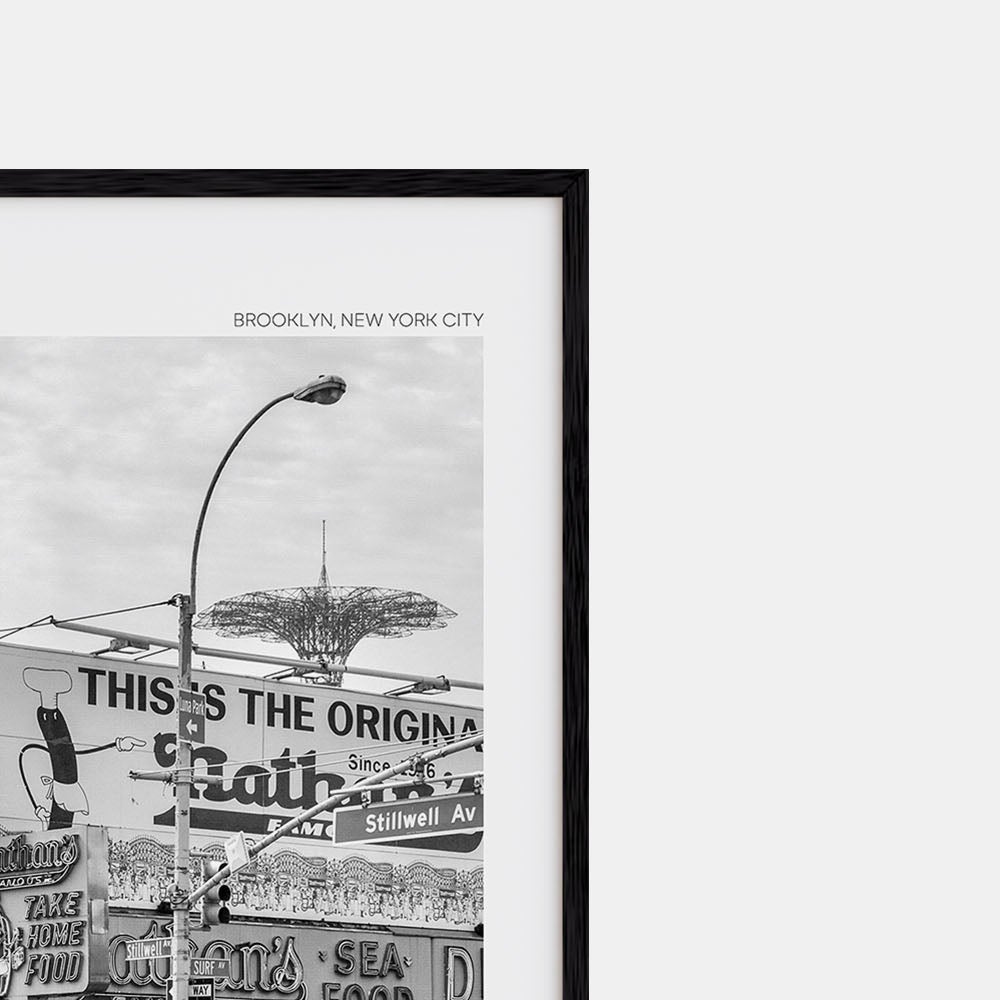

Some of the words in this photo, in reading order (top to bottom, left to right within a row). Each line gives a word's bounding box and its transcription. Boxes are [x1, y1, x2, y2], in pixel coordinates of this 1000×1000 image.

[233, 312, 337, 330] BROOKLYN,
[340, 312, 384, 328] NEW
[387, 312, 438, 328] YORK
[441, 312, 485, 328] CITY
[78, 666, 175, 716] THIS
[189, 682, 226, 722] S
[237, 687, 317, 733] THE
[348, 753, 391, 774] Since
[365, 806, 440, 834] Stillwell
[451, 803, 477, 824] Av
[23, 891, 83, 920] TAKE
[25, 920, 87, 949] HOME
[126, 939, 163, 959] Stillwell
[24, 950, 84, 985] FOOD
[193, 960, 216, 976] SURF
[333, 939, 406, 979] SEA
[192, 985, 209, 996] WAY
